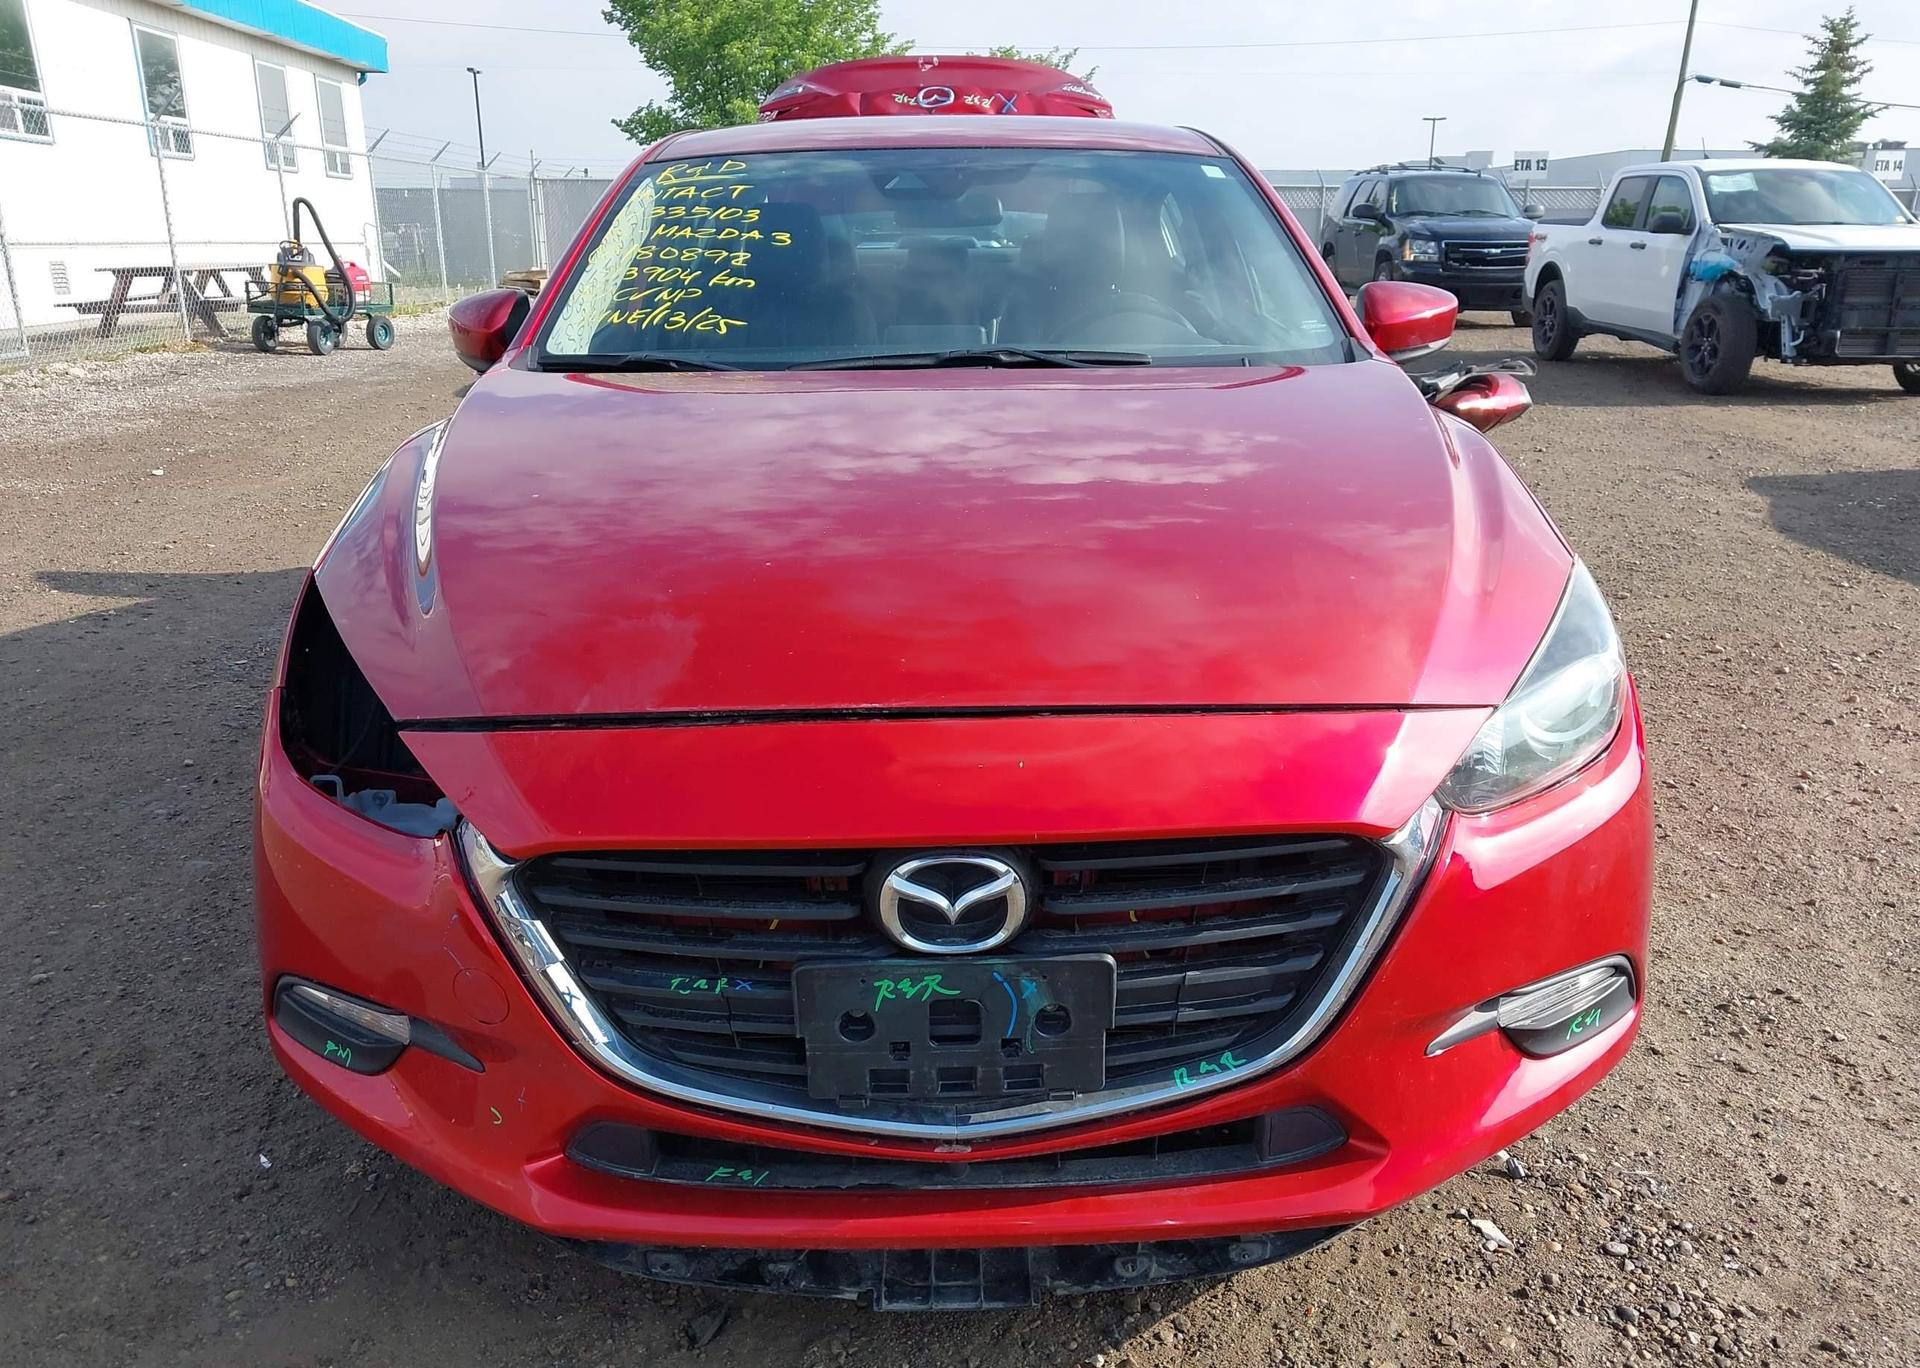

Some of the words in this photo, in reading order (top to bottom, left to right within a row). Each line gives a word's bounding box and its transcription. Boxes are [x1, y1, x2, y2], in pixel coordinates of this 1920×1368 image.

[1514, 159, 1532, 171] ETA
[1536, 159, 1548, 171] 13
[1875, 159, 1890, 171] ETA
[1893, 159, 1903, 171] 14
[650, 223, 765, 241] MAZDA
[770, 231, 793, 246] 3
